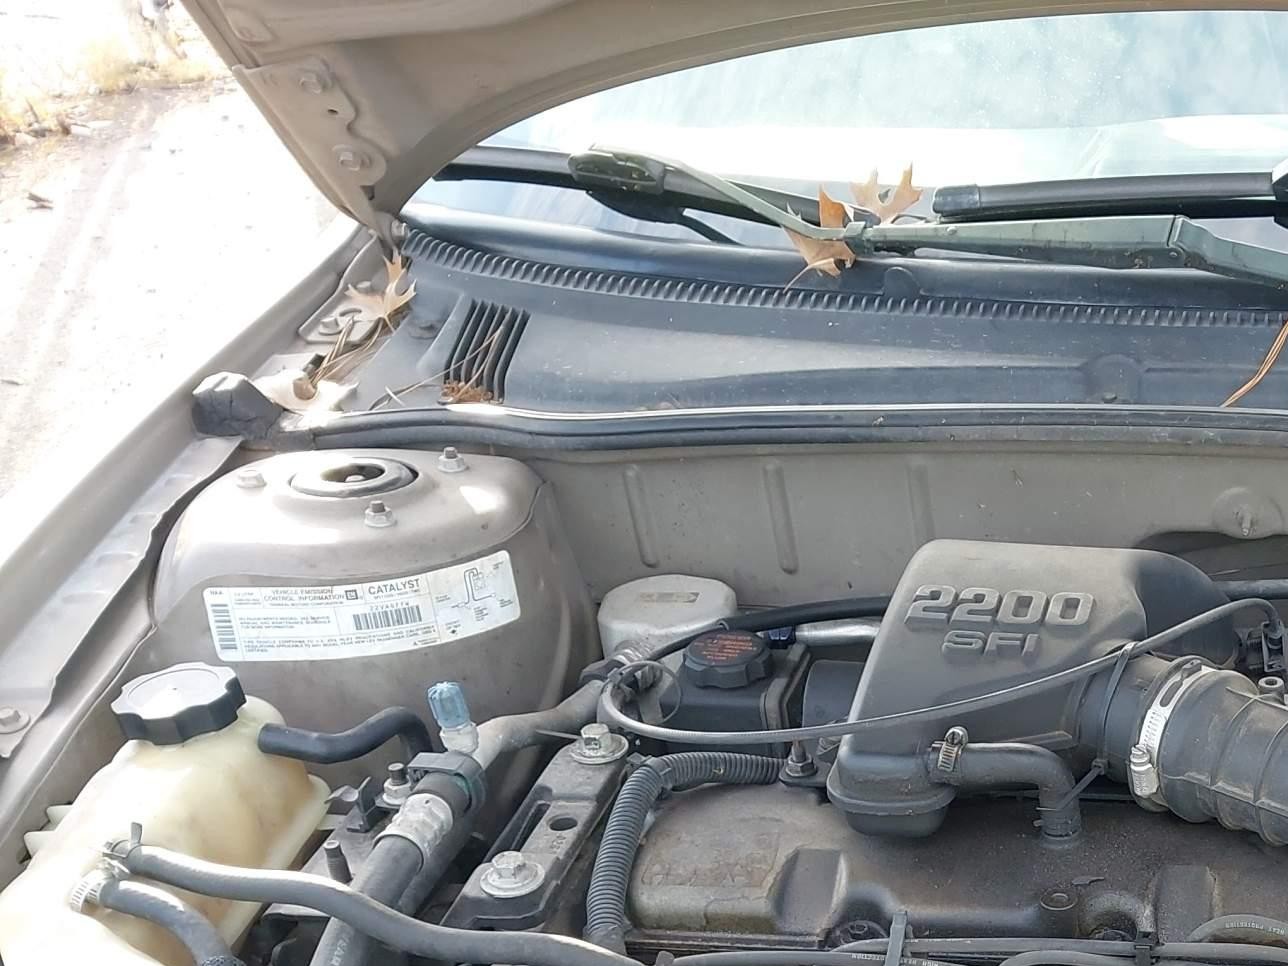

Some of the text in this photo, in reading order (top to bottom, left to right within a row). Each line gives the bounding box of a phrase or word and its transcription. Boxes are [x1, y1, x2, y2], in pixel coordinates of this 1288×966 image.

[368, 578, 420, 595] CATALYST
[904, 584, 1095, 628] 2200
[942, 630, 1040, 657] SFI
